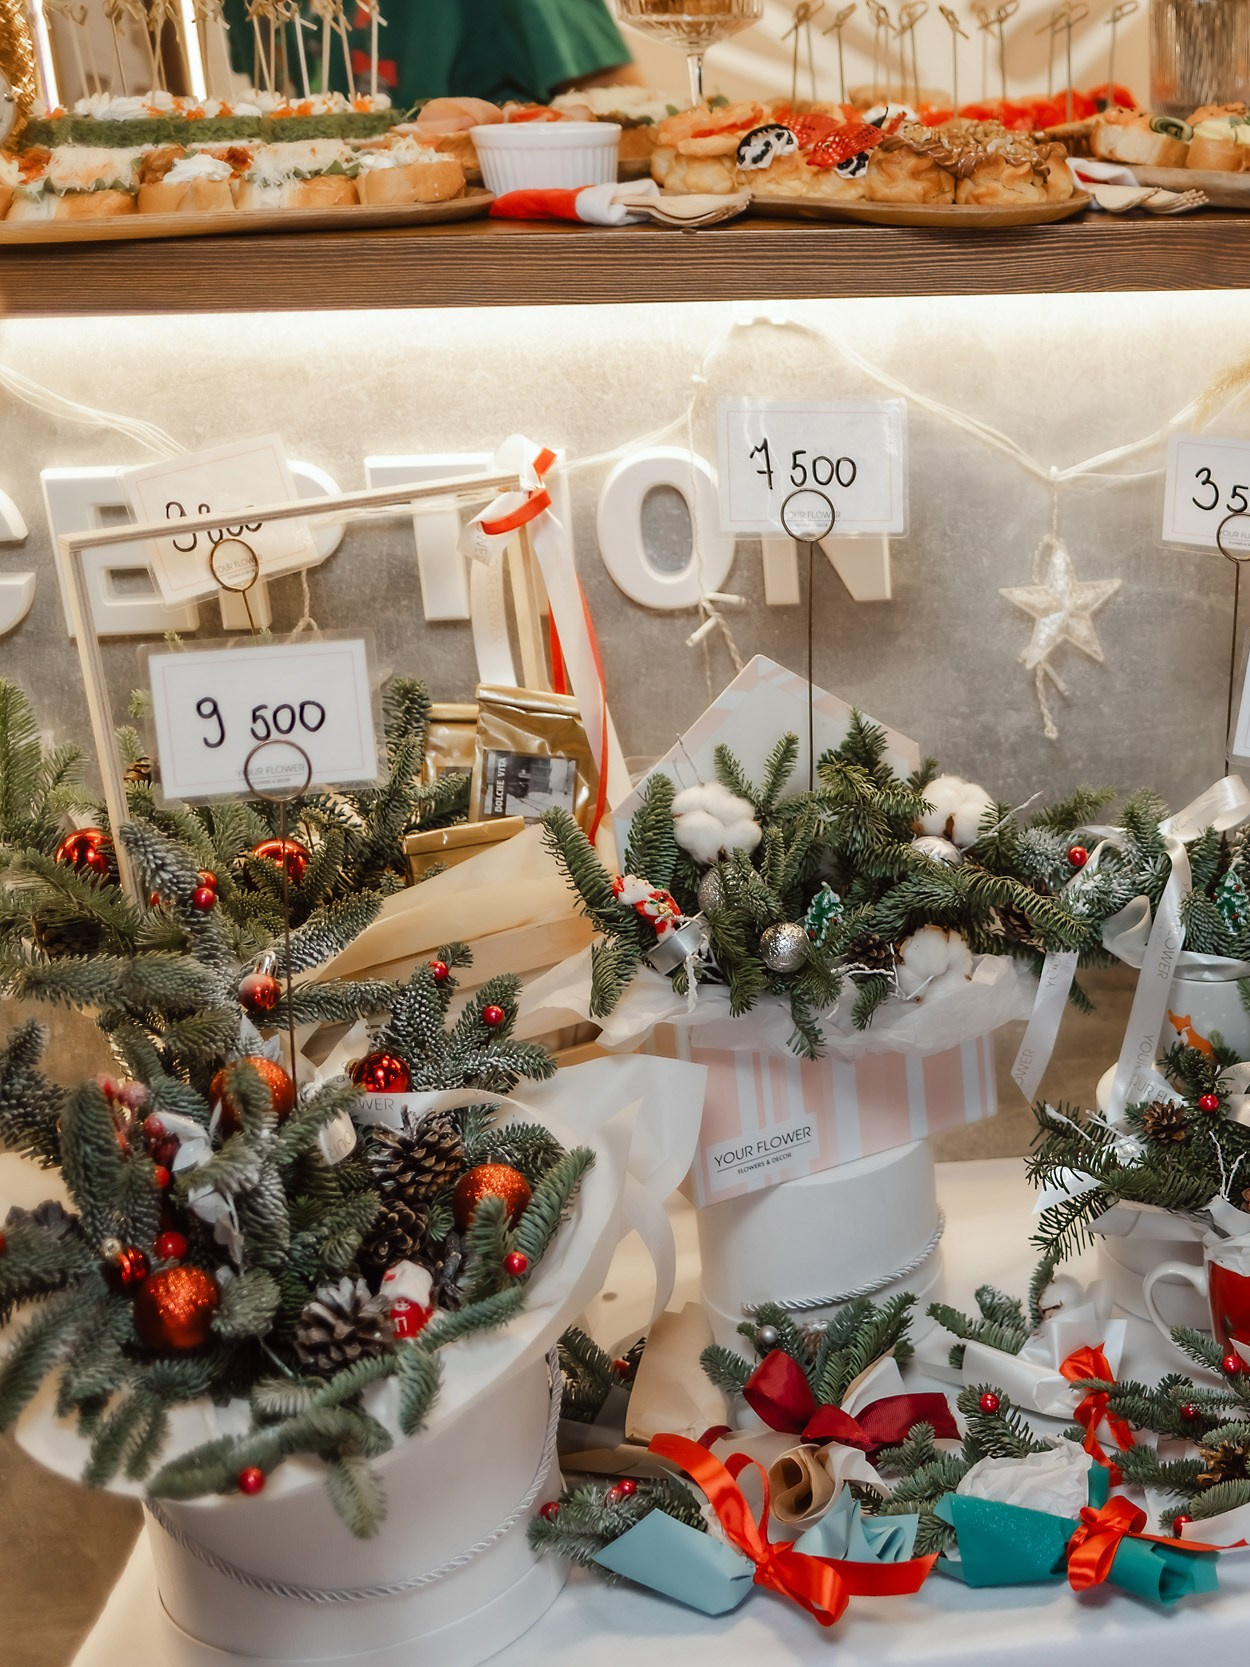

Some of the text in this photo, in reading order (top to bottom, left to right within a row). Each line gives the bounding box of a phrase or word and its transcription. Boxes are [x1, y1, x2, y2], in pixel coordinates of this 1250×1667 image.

[750, 438, 857, 490] 7 500
[1192, 466, 1219, 511] 3
[807, 510, 842, 519] FLOWR
[196, 697, 326, 748] 9 500
[265, 763, 305, 775] FLOWER
[494, 757, 507, 813] DOLCHE VITA
[714, 1126, 812, 1167] YOUR FLOWER
[737, 1161, 765, 1175] FLOWERS
[772, 1152, 792, 1164] DECOR
